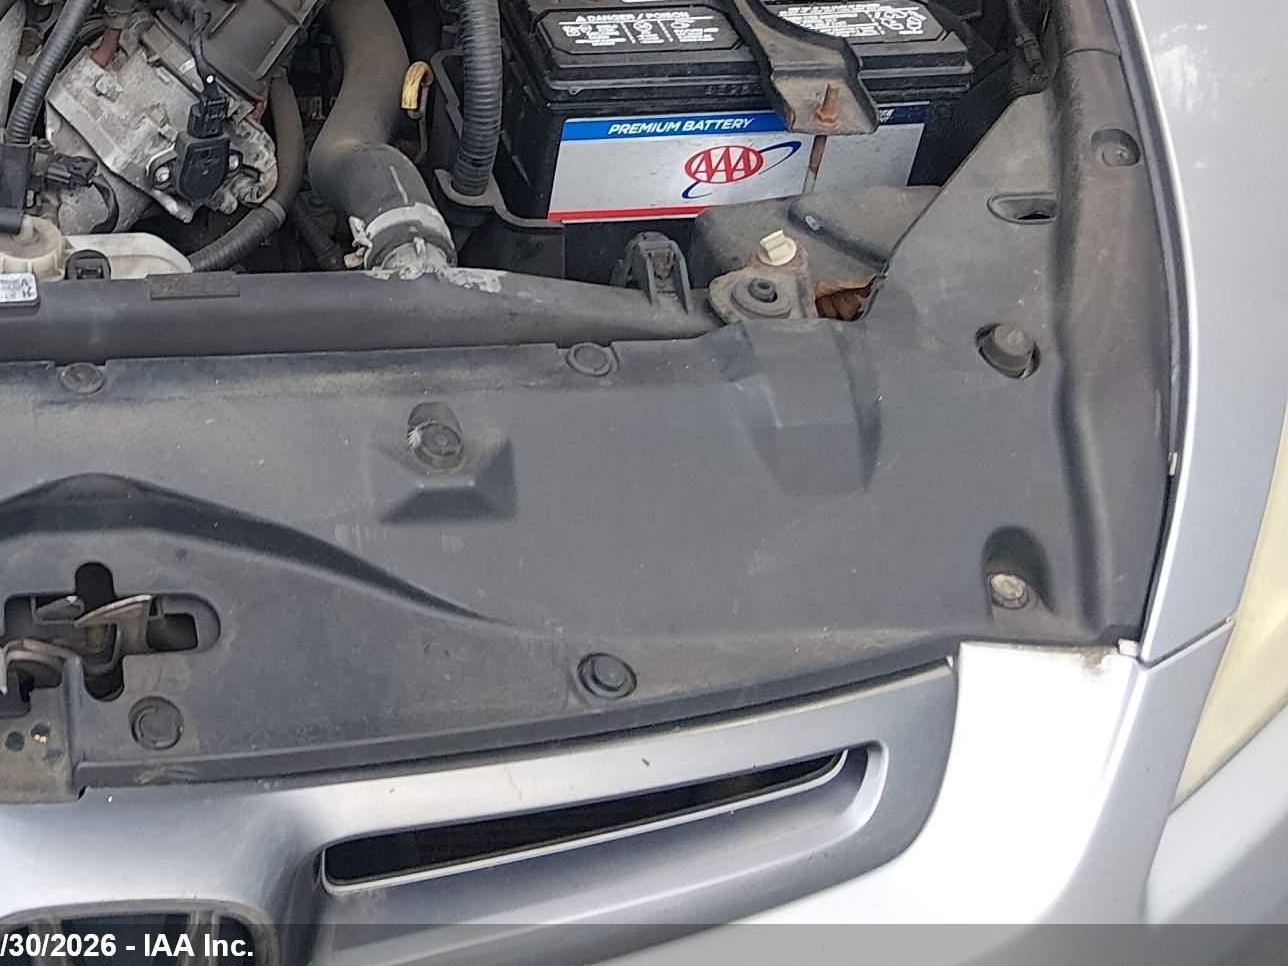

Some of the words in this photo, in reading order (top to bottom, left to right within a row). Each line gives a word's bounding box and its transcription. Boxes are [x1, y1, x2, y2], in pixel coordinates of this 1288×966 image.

[608, 121, 681, 135] PREMIUM
[684, 117, 756, 132] BATTERY
[688, 146, 756, 183] AAA
